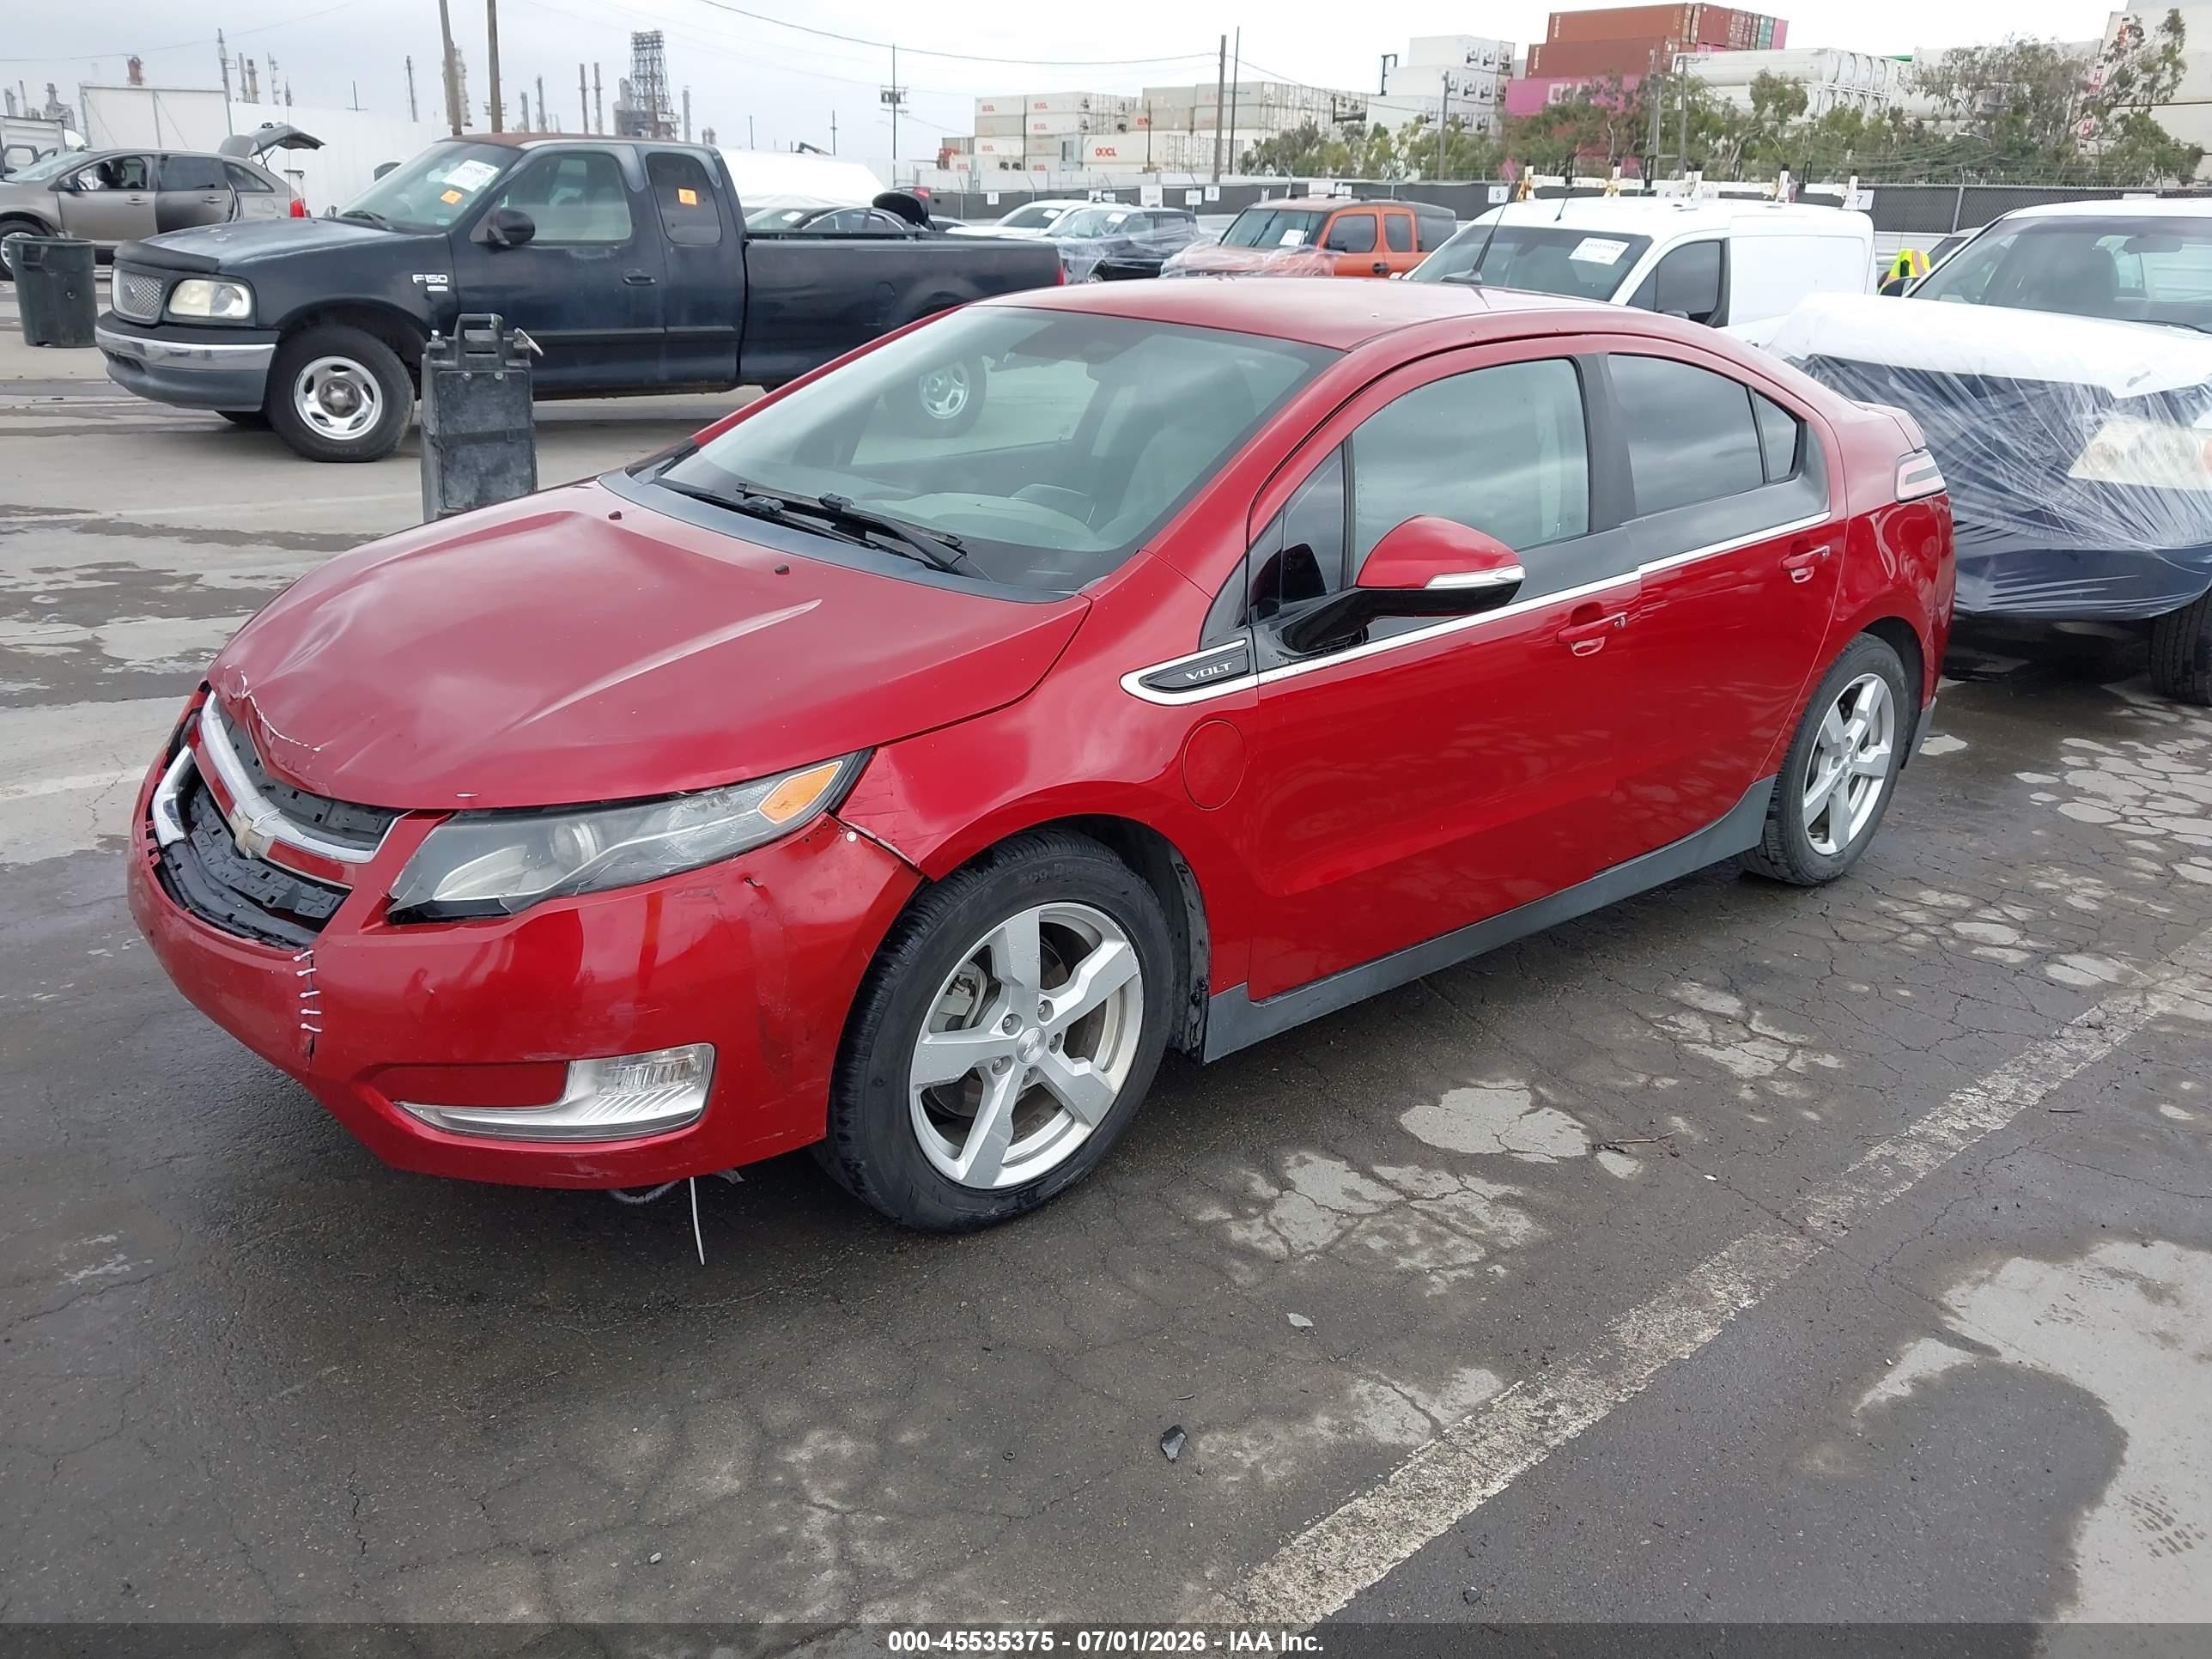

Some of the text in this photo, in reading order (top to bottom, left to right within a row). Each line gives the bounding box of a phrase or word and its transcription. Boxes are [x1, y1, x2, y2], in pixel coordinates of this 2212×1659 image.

[1095, 148, 1117, 156] OOCL
[1495, 191, 1501, 199] 5
[1185, 661, 1232, 681] VOLT
